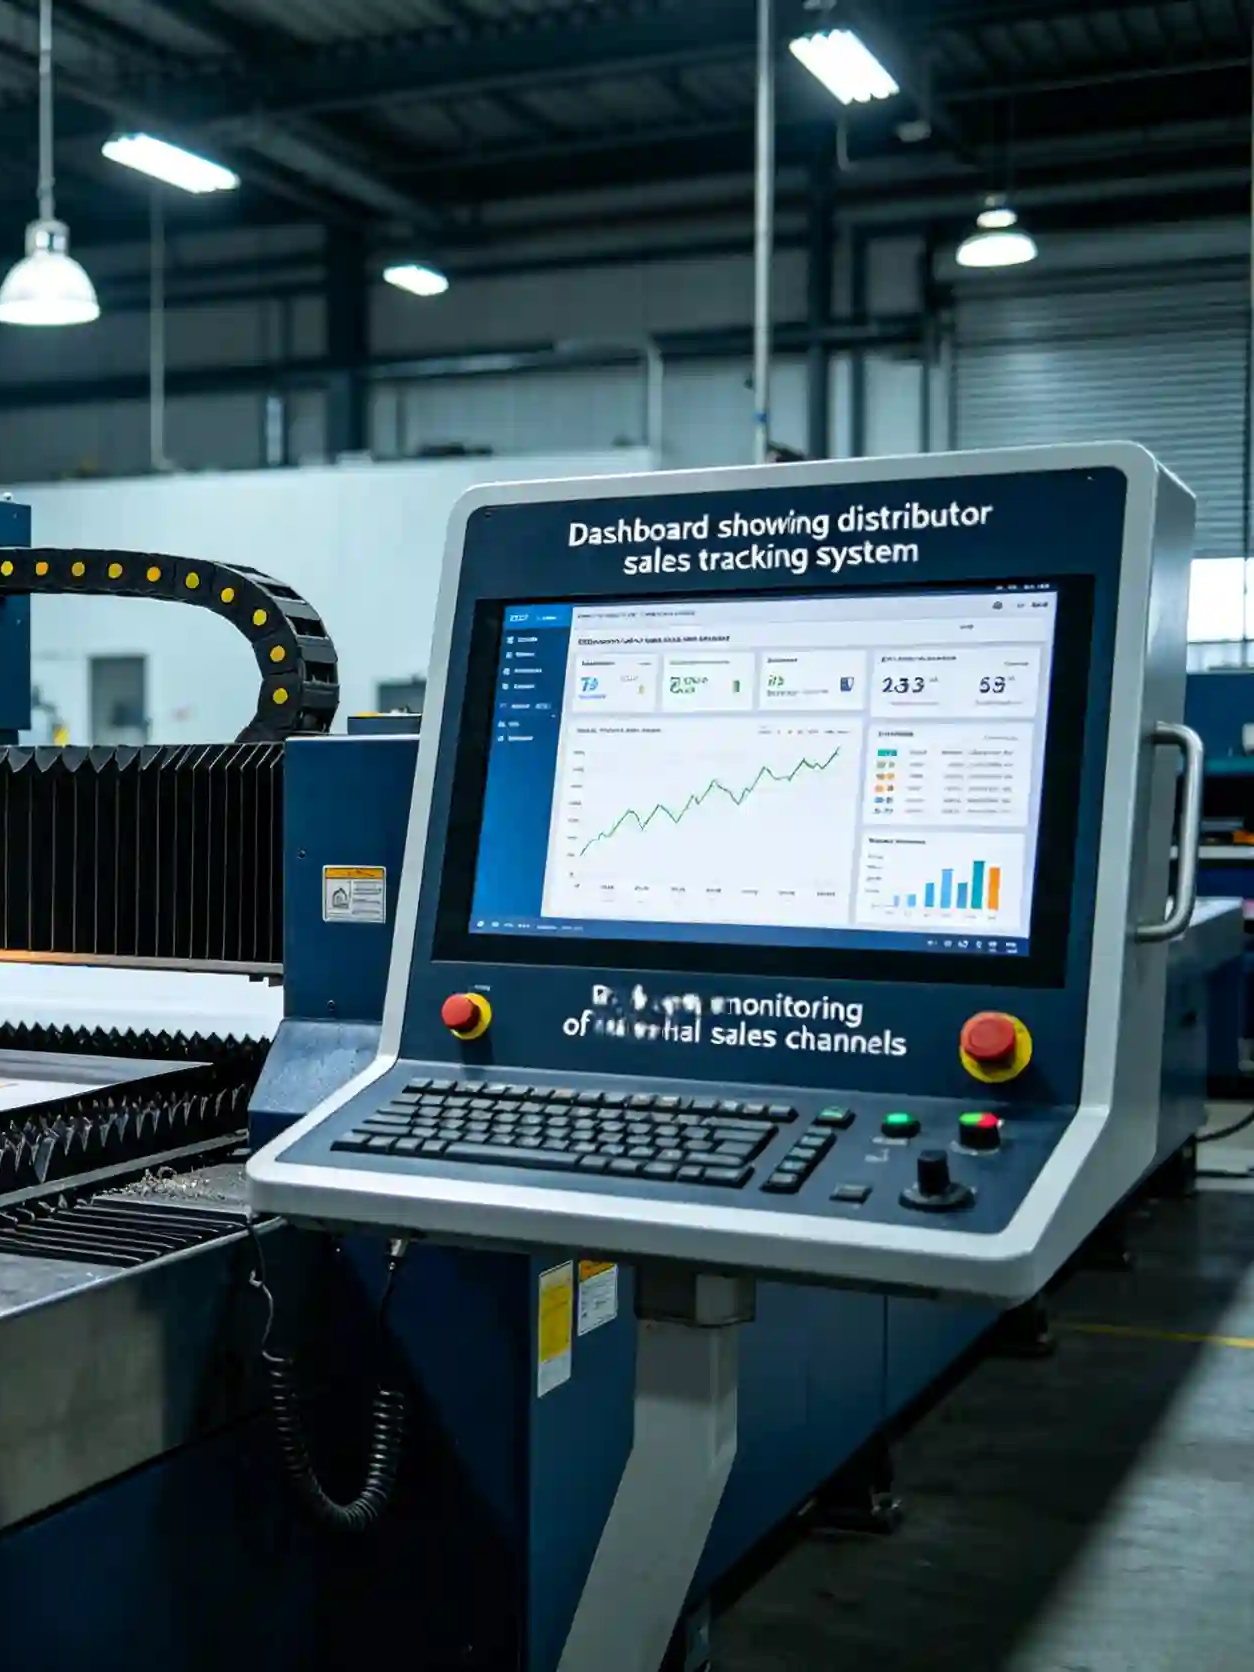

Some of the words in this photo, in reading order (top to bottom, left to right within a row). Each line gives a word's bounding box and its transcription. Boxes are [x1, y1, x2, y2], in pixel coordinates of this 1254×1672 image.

[568, 514, 709, 547] Dashboard
[717, 509, 830, 541] showing
[837, 502, 993, 532] distributor
[623, 547, 691, 575] sales
[698, 543, 808, 574] tracking
[815, 541, 919, 573] system
[562, 1010, 593, 1037] of
[710, 1021, 778, 1047] sales
[785, 1025, 908, 1056] channels
